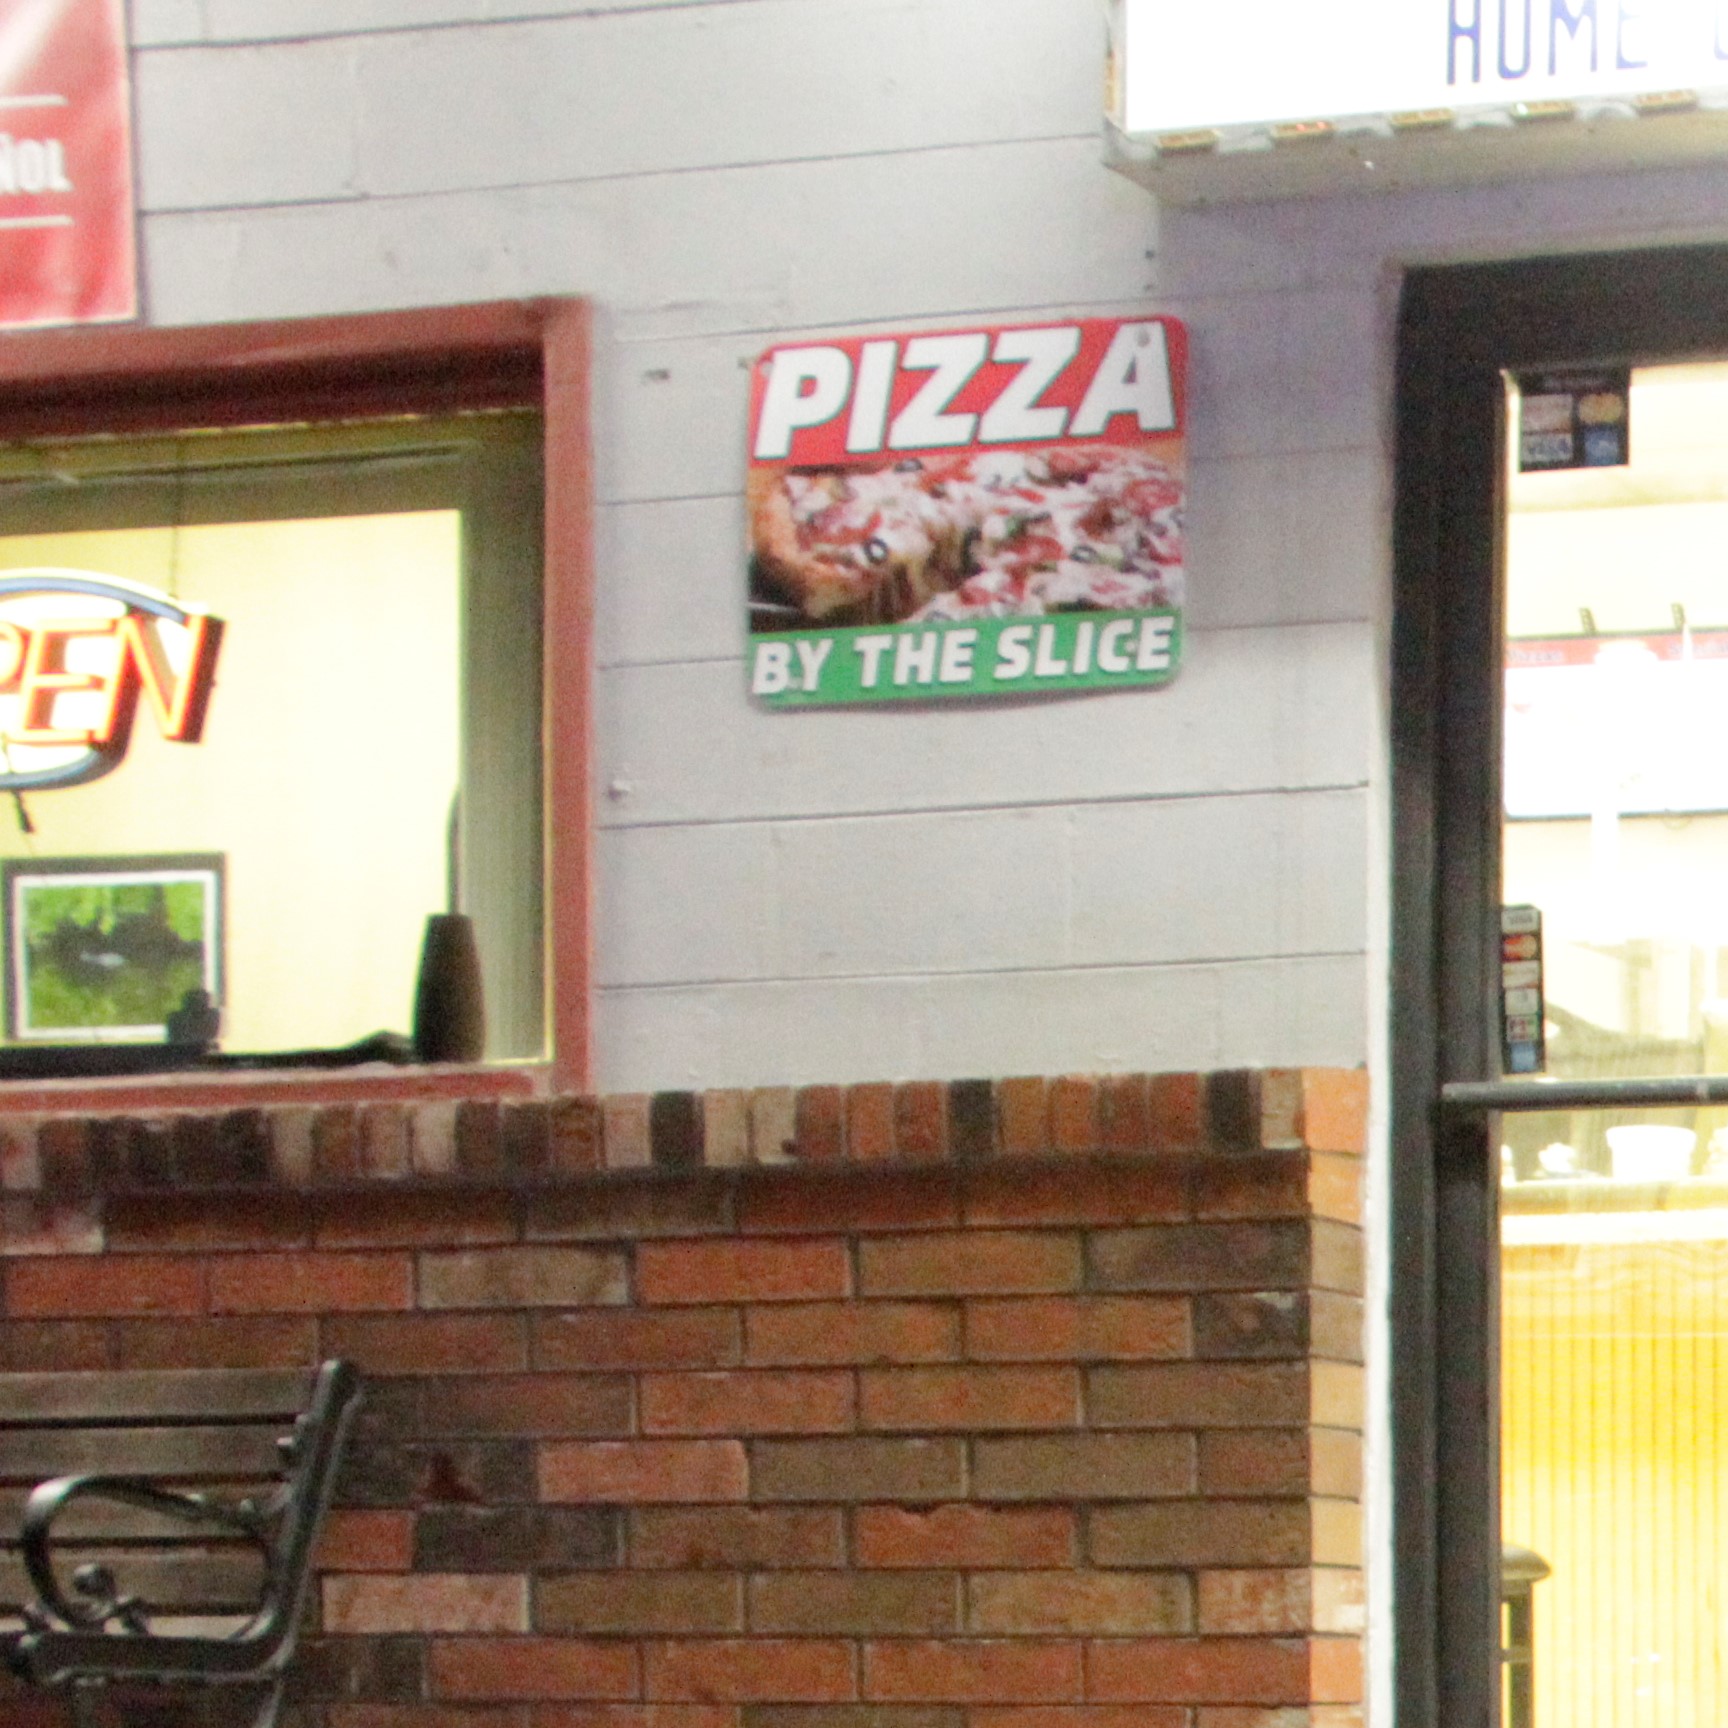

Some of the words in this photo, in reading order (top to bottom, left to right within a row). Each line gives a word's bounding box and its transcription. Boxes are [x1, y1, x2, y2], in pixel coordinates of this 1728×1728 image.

[1446, 0, 1648, 86] HOME
[753, 319, 1177, 460] PIZZA
[752, 637, 832, 695] BY
[854, 627, 979, 688] THE
[993, 615, 1176, 680] SLICE
